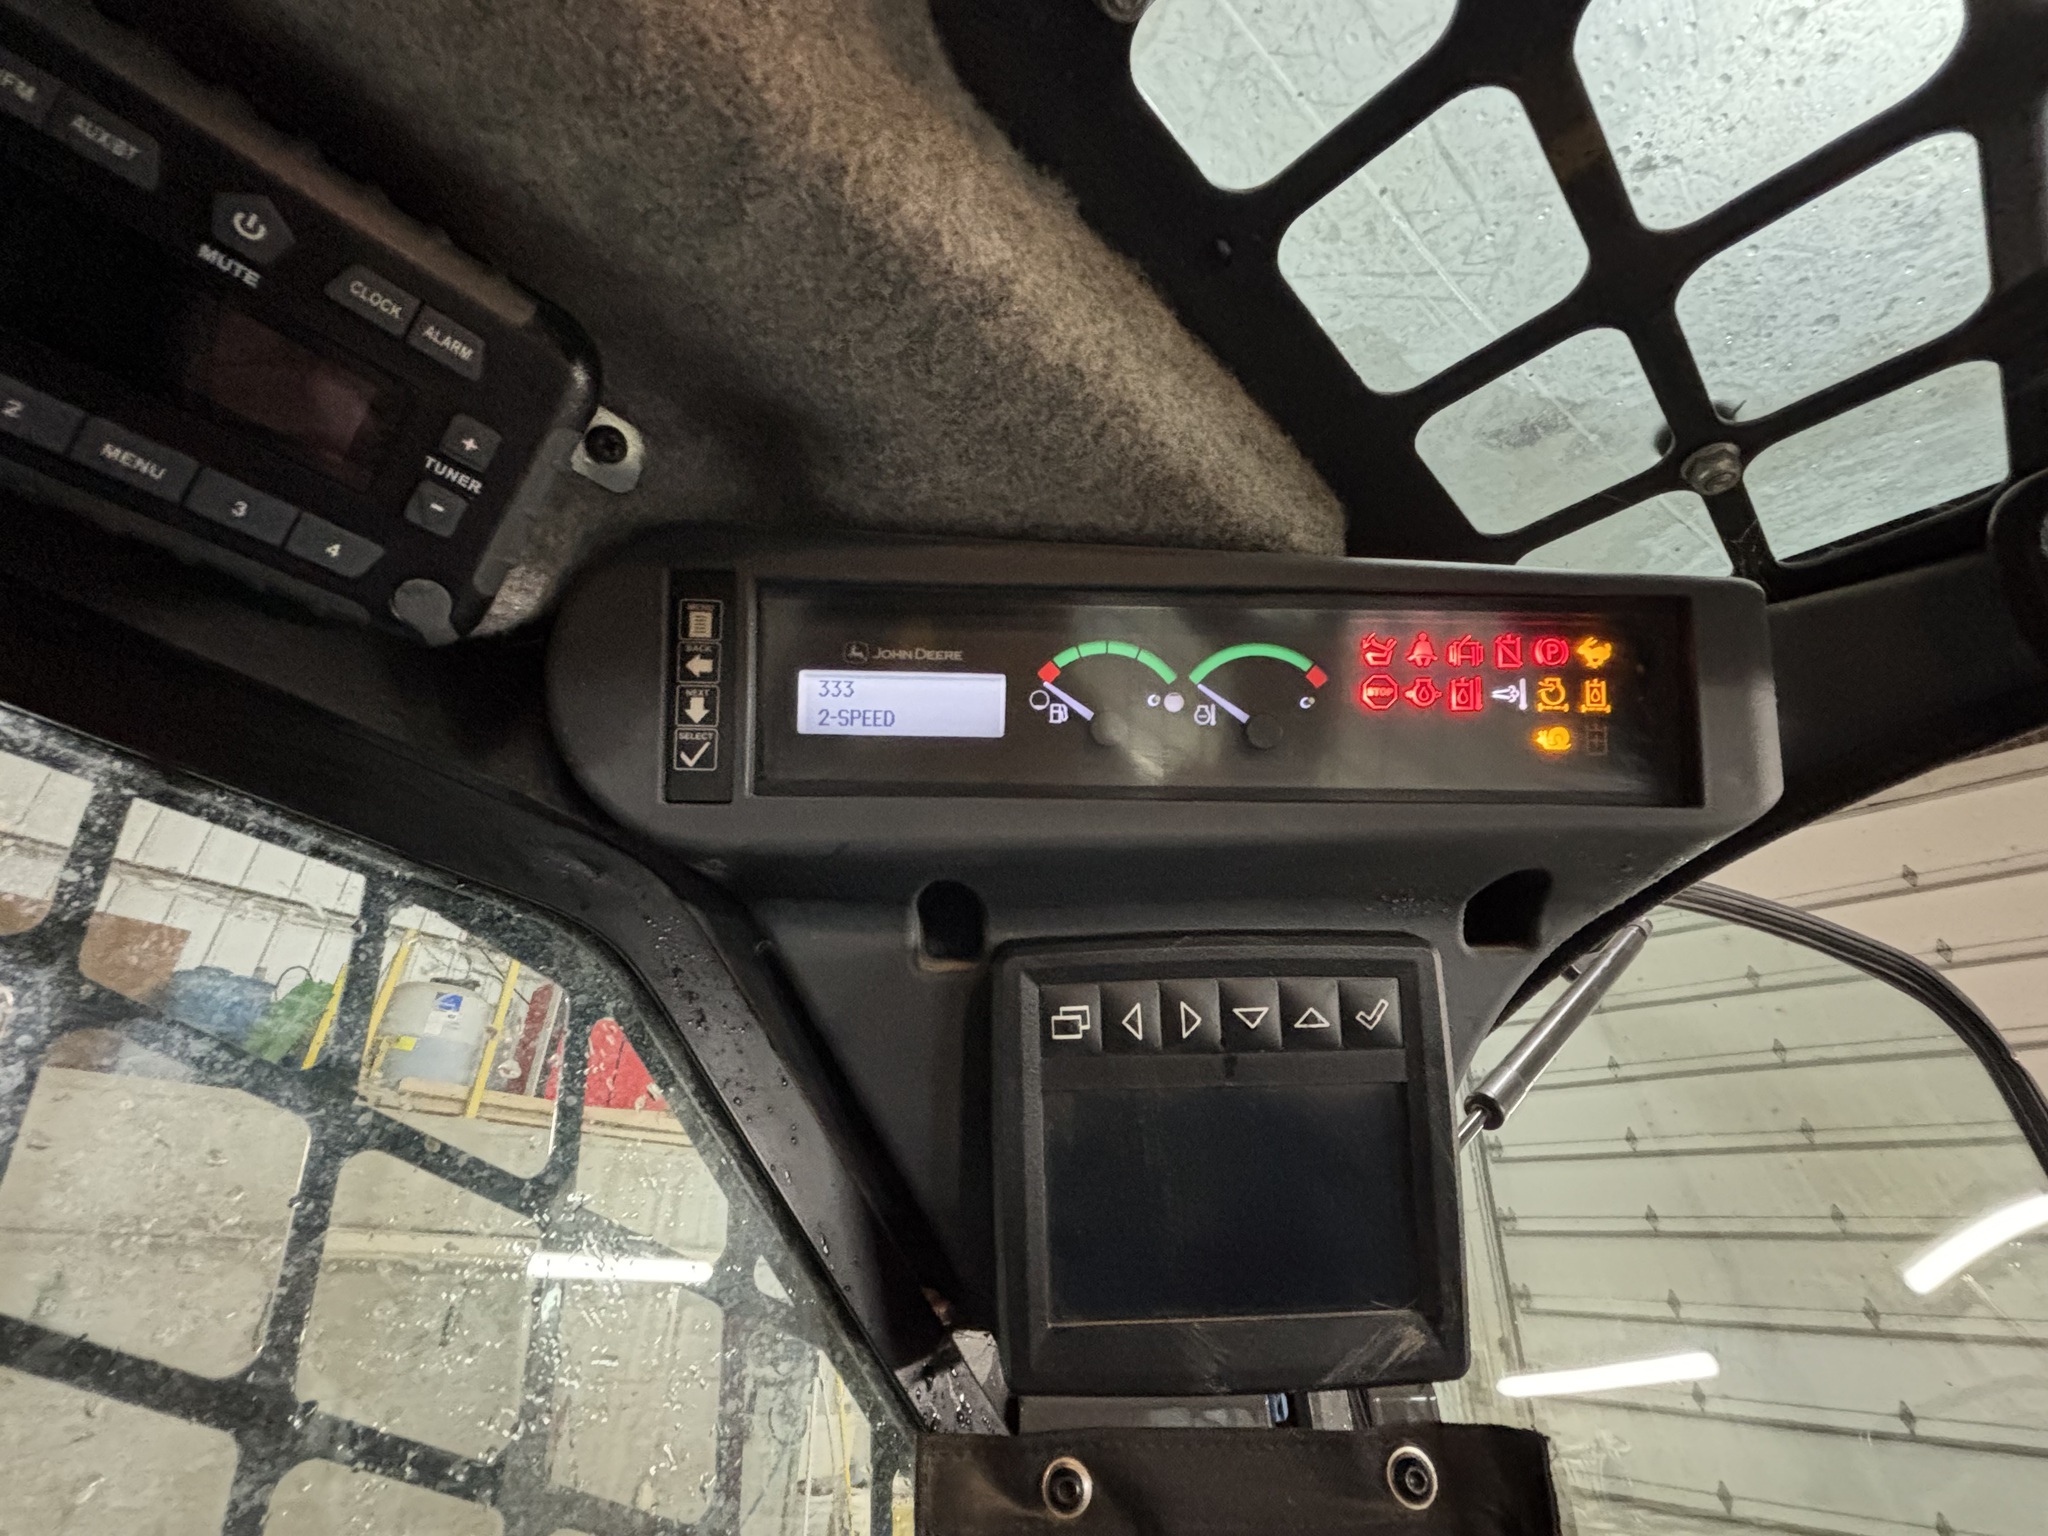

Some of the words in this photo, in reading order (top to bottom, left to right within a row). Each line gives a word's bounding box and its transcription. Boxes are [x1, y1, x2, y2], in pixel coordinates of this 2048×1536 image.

[198, 243, 261, 288] MUTE
[350, 280, 403, 319] CLOCK
[422, 325, 473, 361] ALARM
[1, 399, 24, 418] 2
[101, 443, 167, 480] MENU
[425, 455, 483, 495] TUNER
[231, 500, 248, 517] 3
[325, 543, 341, 558] 4
[872, 647, 913, 660] JOHN
[915, 647, 964, 661] DEERE
[685, 688, 711, 697] NEXT
[818, 679, 855, 698] 333
[1367, 686, 1394, 697] STOP
[818, 708, 896, 727] 2-SPEED
[679, 731, 714, 741] SELECT
